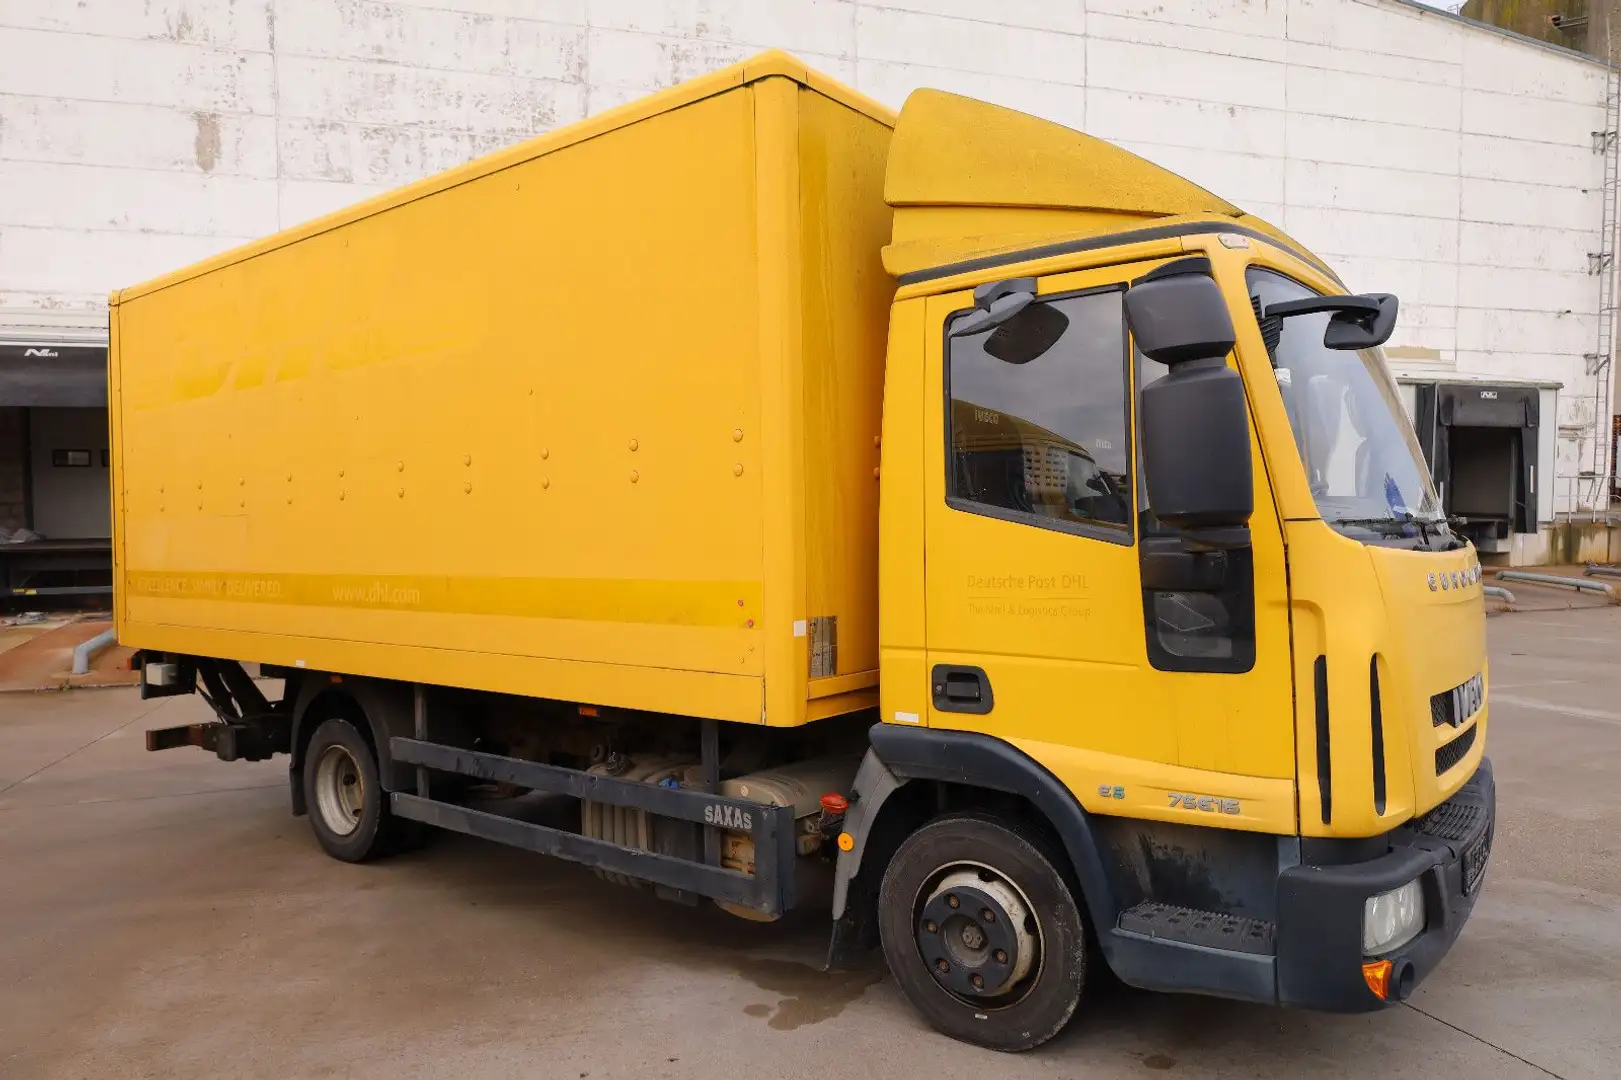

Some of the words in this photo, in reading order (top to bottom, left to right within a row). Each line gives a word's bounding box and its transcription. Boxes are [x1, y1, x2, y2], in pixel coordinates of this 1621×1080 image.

[332, 579, 420, 604] www.dhl.com
[967, 573, 1024, 589] Deutsche
[1028, 574, 1056, 589] Post
[1061, 574, 1090, 589] DHL
[1018, 604, 1058, 619] Logistics
[1060, 605, 1092, 621] Group
[704, 804, 753, 829] SAXAS
